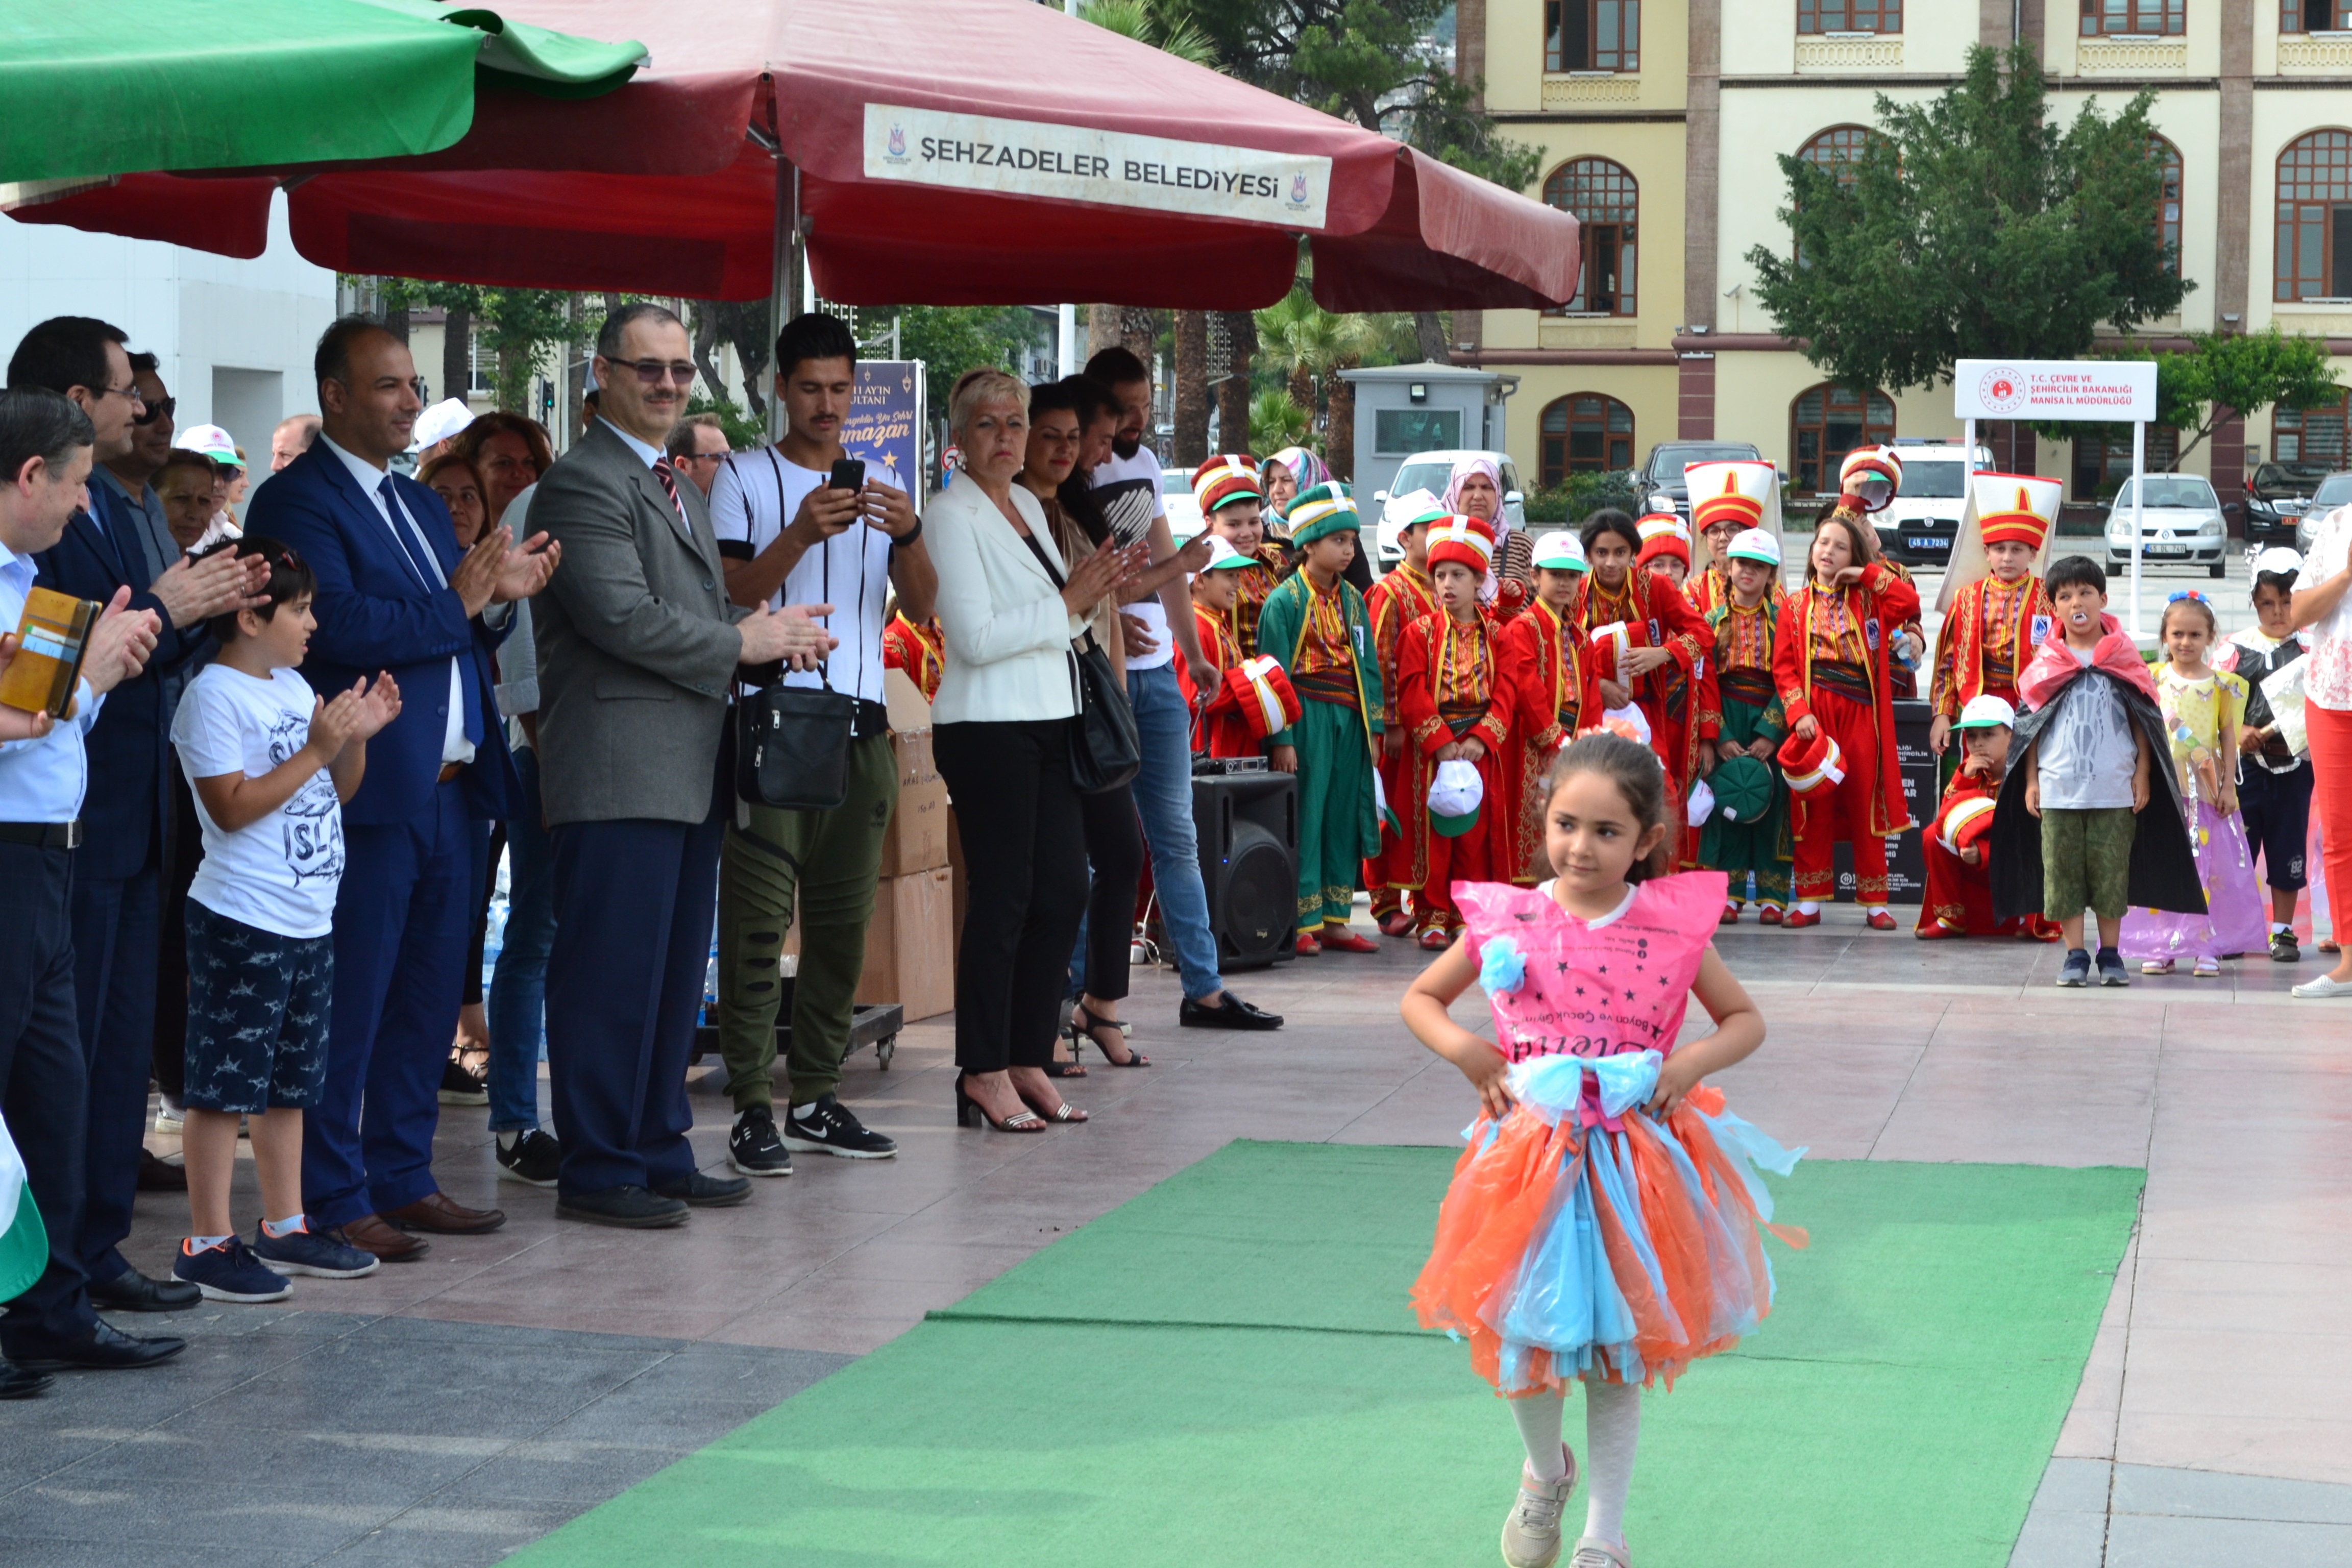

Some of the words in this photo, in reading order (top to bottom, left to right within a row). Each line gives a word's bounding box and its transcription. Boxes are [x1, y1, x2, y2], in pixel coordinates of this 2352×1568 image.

[921, 137, 1109, 179] ŞEHZADELER
[2050, 375, 2078, 384] ÇEVRE
[2030, 384, 2079, 395] ŞEHİRCİLİK
[2082, 384, 2132, 394] BAKANLIĞI
[850, 396, 886, 405] ULTANI
[2030, 395, 2064, 404] MANİSA
[2067, 395, 2074, 404] İL
[2076, 395, 2132, 405] MÜDÜRLÜĞÜ
[839, 424, 910, 448] amazan
[282, 815, 344, 860] ISLA
[1521, 1013, 1554, 1025] Giyim
[1556, 1010, 1595, 1023] Çocuk
[1600, 1014, 1612, 1022] ve
[1616, 1015, 1649, 1032] Bayan
